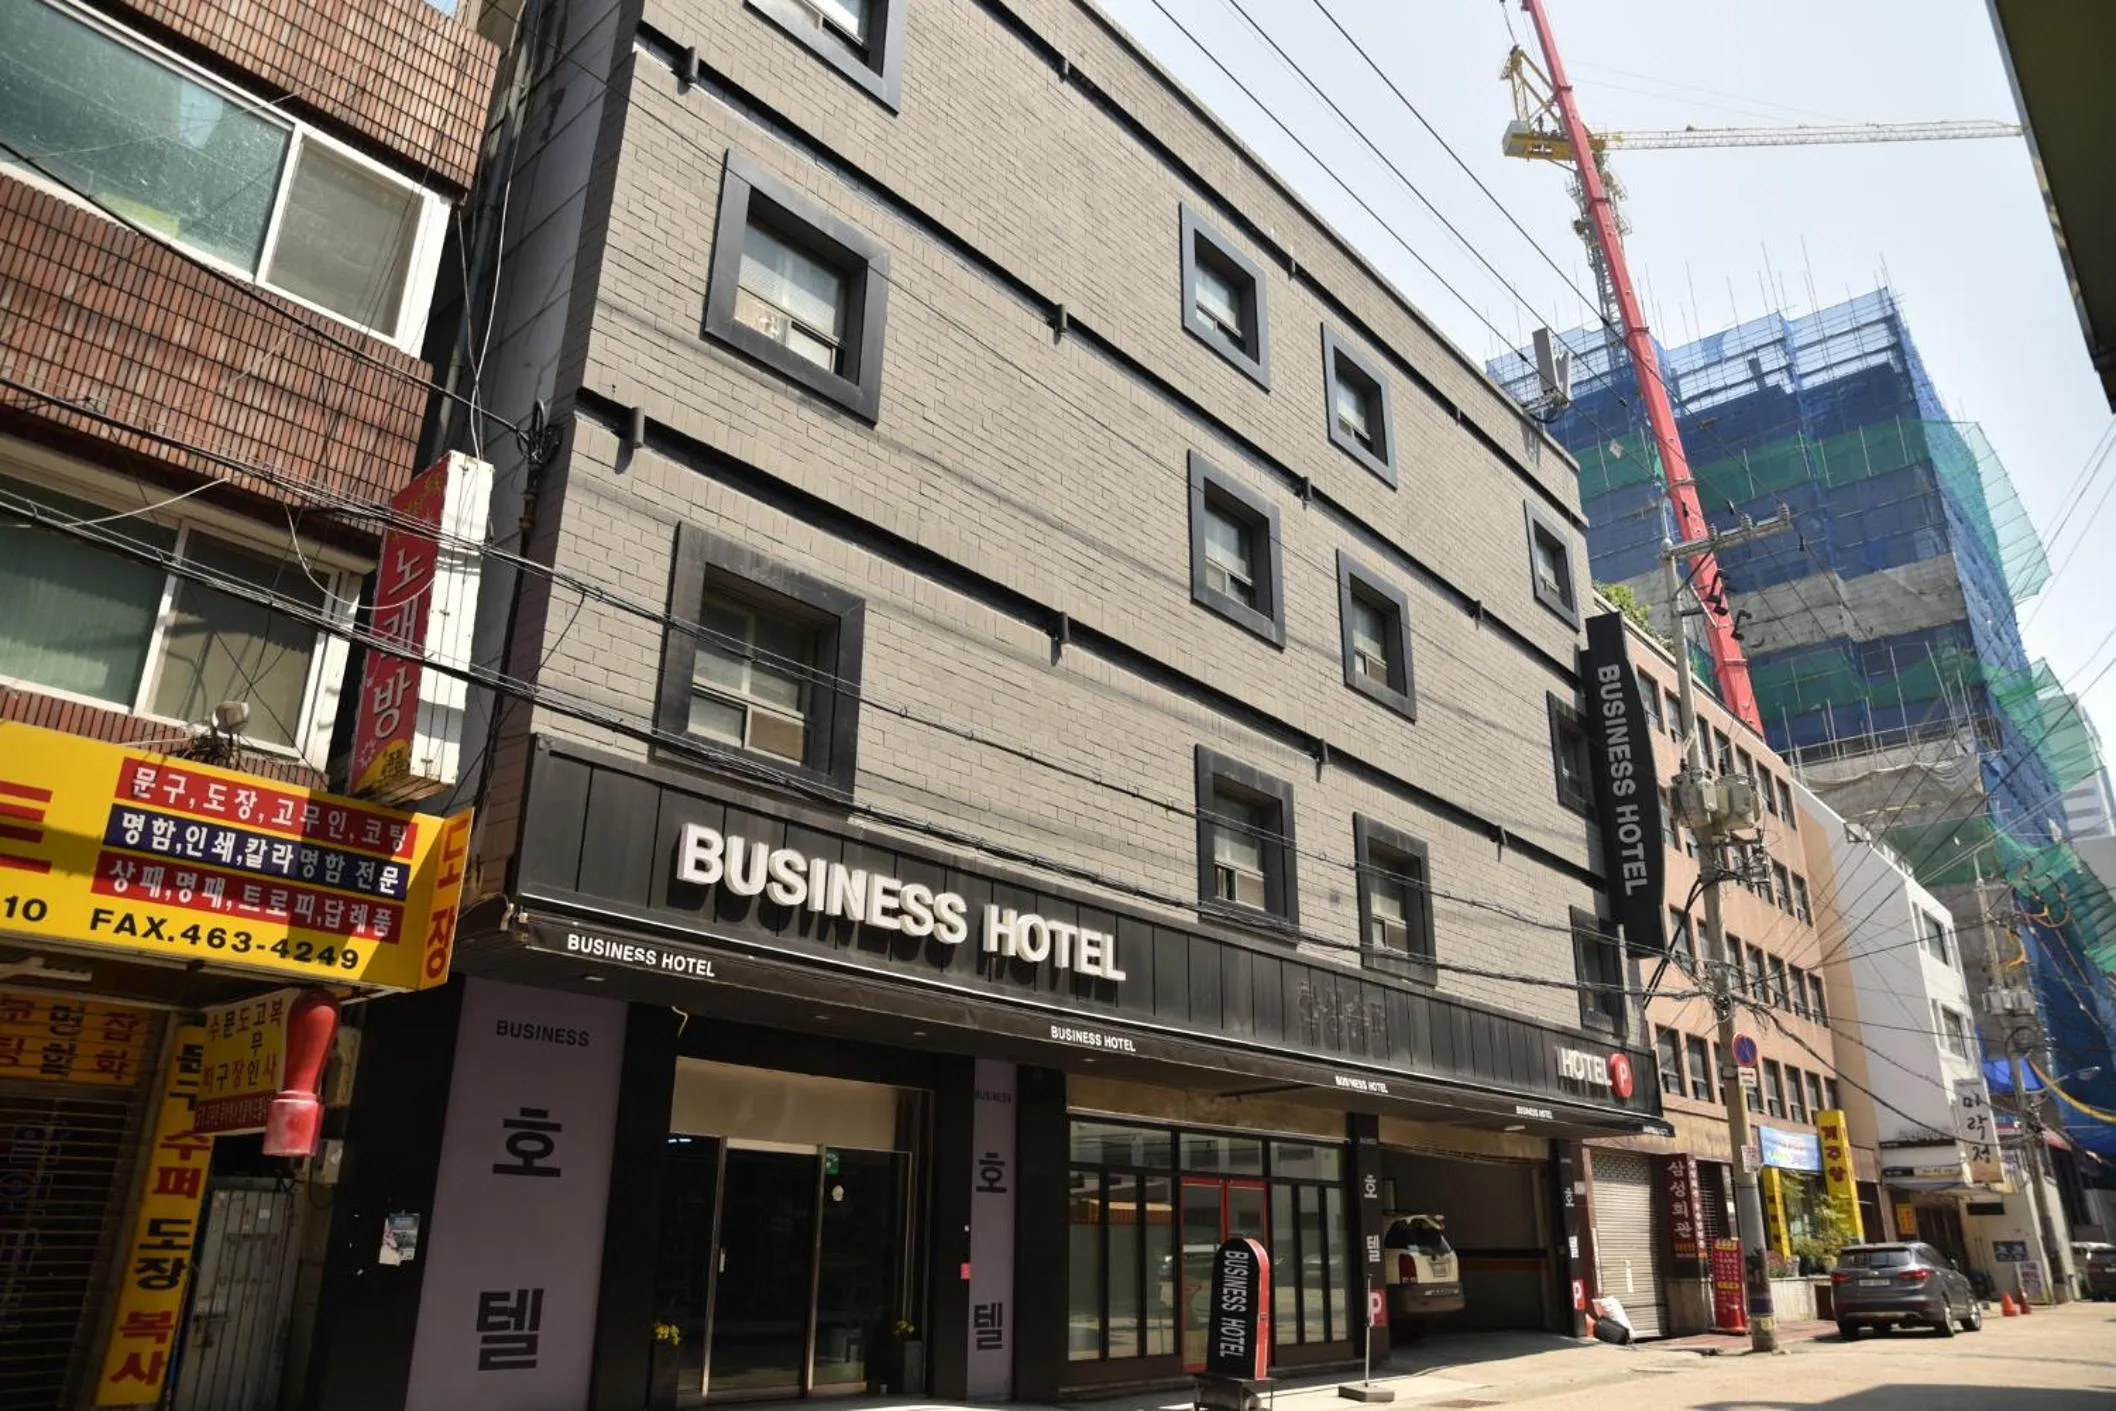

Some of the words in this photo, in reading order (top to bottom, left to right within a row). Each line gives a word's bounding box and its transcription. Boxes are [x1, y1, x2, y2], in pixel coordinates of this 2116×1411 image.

[372, 547, 425, 740] 노래방
[1598, 663, 1637, 798] BUSINESS
[1616, 804, 1648, 896] HOTEL
[426, 818, 468, 980] 도장
[677, 822, 968, 944] BUSINESS
[982, 902, 1128, 981] HOTEL
[567, 933, 659, 966] BUSINESS
[661, 952, 715, 978] HOTEL
[215, 1009, 236, 1093] 문구
[232, 1004, 251, 1090] 도장
[496, 1018, 590, 1048] BUSINESS
[1050, 1024, 1103, 1047] BUSINESS
[1103, 1034, 1137, 1052] HOTEL
[1557, 1047, 1613, 1087] HOTEL
[1335, 1075, 1368, 1090] BUSINESS
[1368, 1081, 1389, 1094] HOTEL
[152, 1130, 210, 1200] 수퍼
[136, 1218, 193, 1291] 도장
[476, 1106, 563, 1372] 호텔
[973, 1151, 1007, 1351] 호텔
[1364, 1173, 1381, 1263] 호텔
[1221, 1249, 1249, 1313] BUSINESS
[110, 1310, 174, 1387] 복사
[1220, 1317, 1246, 1358] HOTEL
